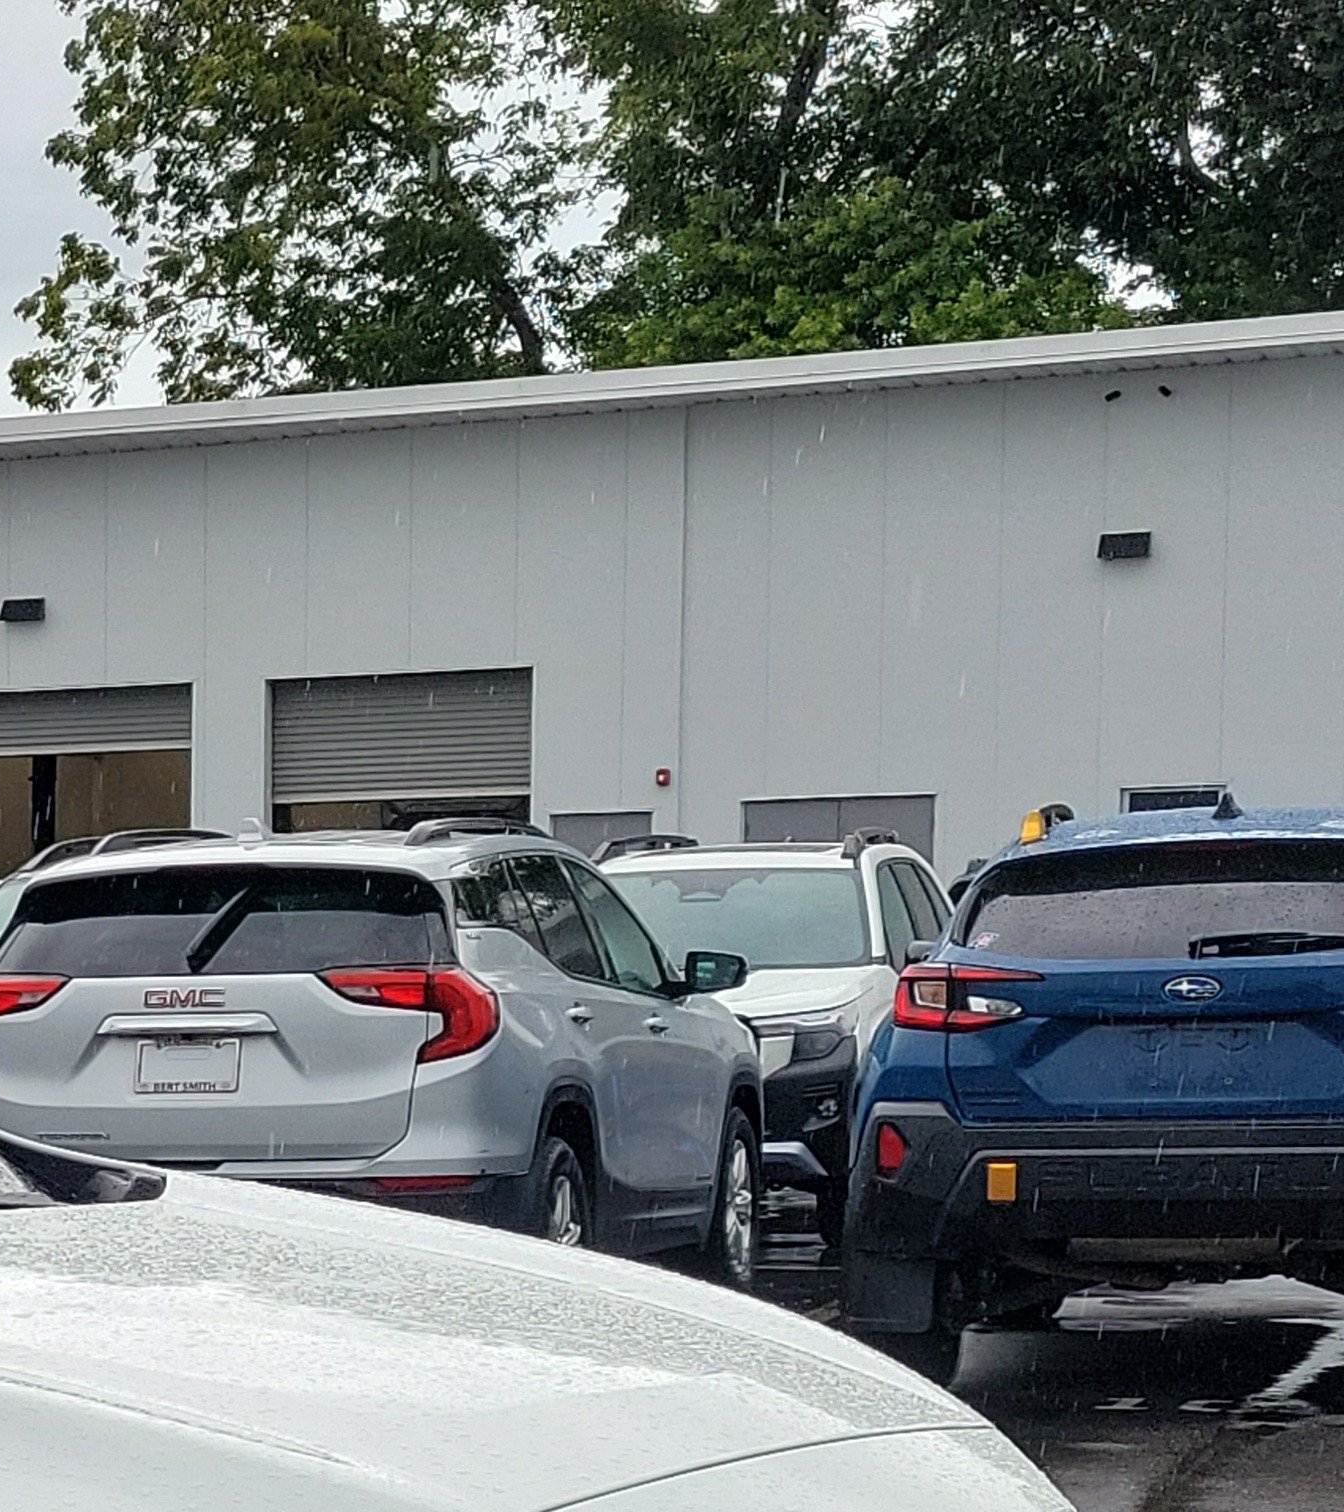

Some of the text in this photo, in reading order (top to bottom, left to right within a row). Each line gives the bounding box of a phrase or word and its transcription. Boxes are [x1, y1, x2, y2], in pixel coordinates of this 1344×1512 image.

[144, 988, 226, 1009] GMC
[153, 1082, 216, 1092] BERT SMITH
